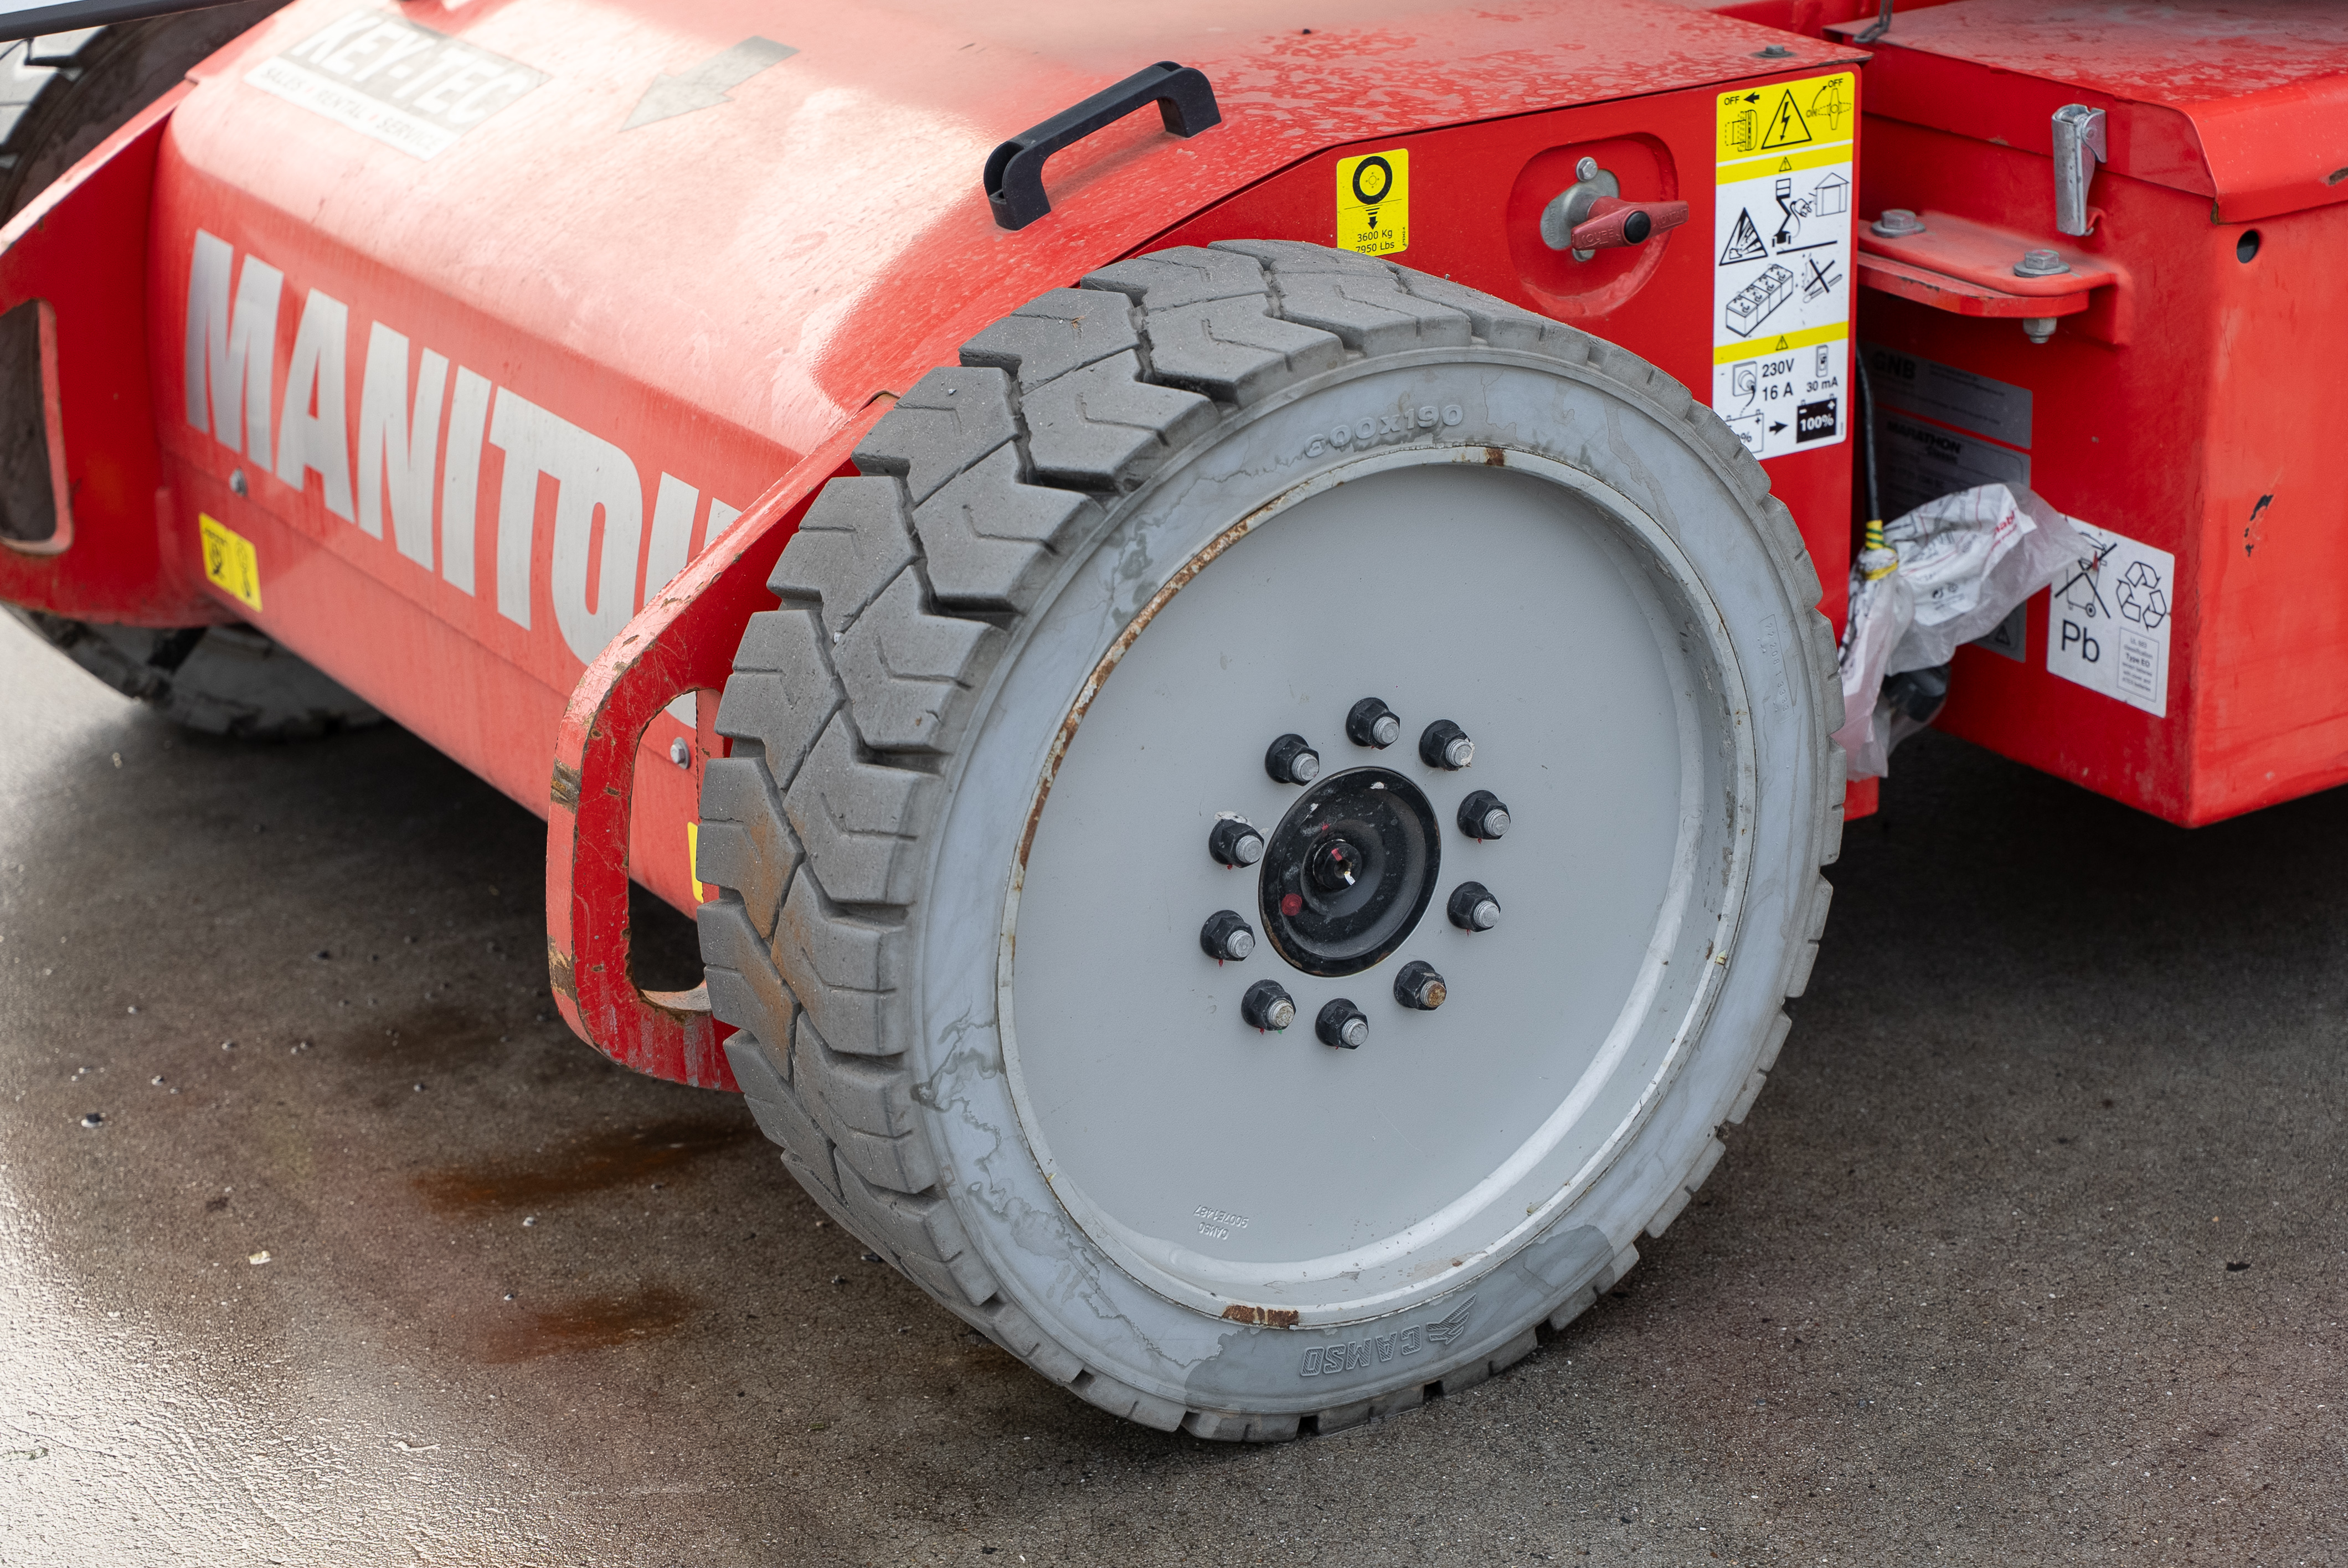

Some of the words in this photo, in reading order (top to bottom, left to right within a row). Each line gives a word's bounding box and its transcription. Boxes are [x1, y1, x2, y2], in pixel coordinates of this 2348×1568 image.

[291, 8, 534, 124] KEY-TEC
[1828, 78, 1844, 88] OFF
[260, 66, 307, 92] SALES
[313, 88, 366, 120] RENTAL
[375, 114, 443, 152] SERVICE
[1724, 96, 1740, 106] OFF
[1357, 230, 1378, 243] 3600
[1382, 229, 1393, 239] Kg
[1380, 241, 1395, 250] Lbs
[1762, 358, 1795, 378] 230V
[1762, 385, 1779, 401] 16
[1783, 382, 1793, 396] A
[1806, 380, 1819, 393] 30
[1821, 376, 1839, 390] mA
[1304, 404, 1465, 458] 600x190
[1800, 414, 1834, 432] 100%
[2061, 618, 2101, 664] Pb
[1197, 1221, 1229, 1241] CAMSO
[1300, 1324, 1424, 1377] CAMSO
